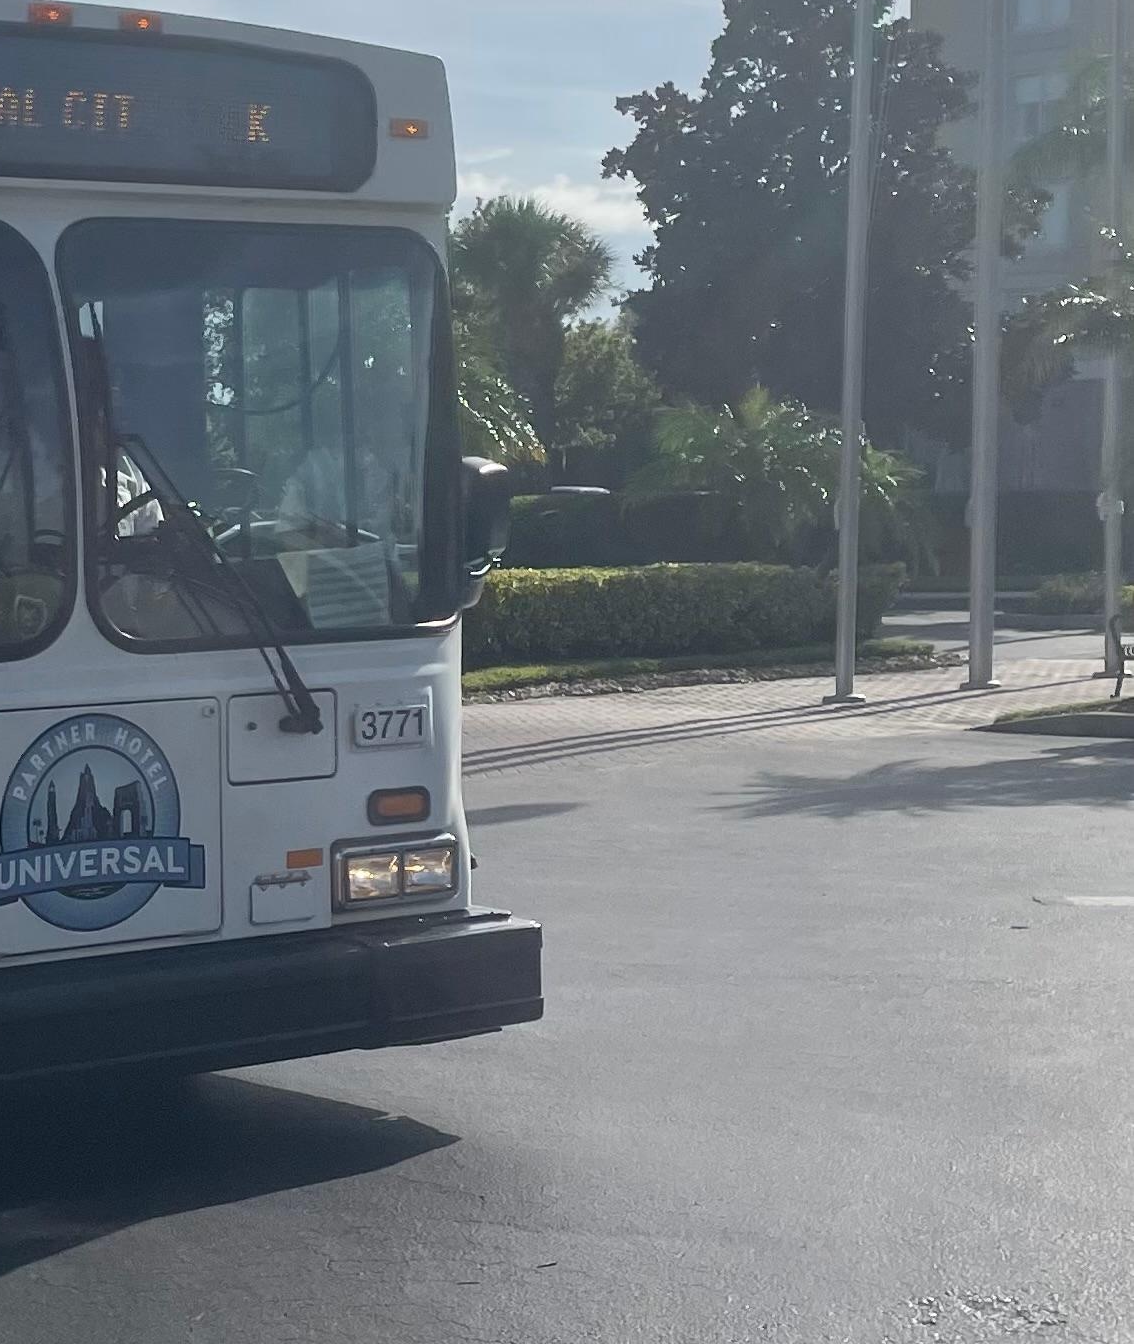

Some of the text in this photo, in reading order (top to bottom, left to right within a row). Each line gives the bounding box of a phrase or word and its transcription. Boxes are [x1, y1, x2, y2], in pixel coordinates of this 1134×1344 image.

[361, 708, 424, 741] 3771
[12, 722, 169, 802] PARTNER HOTEL
